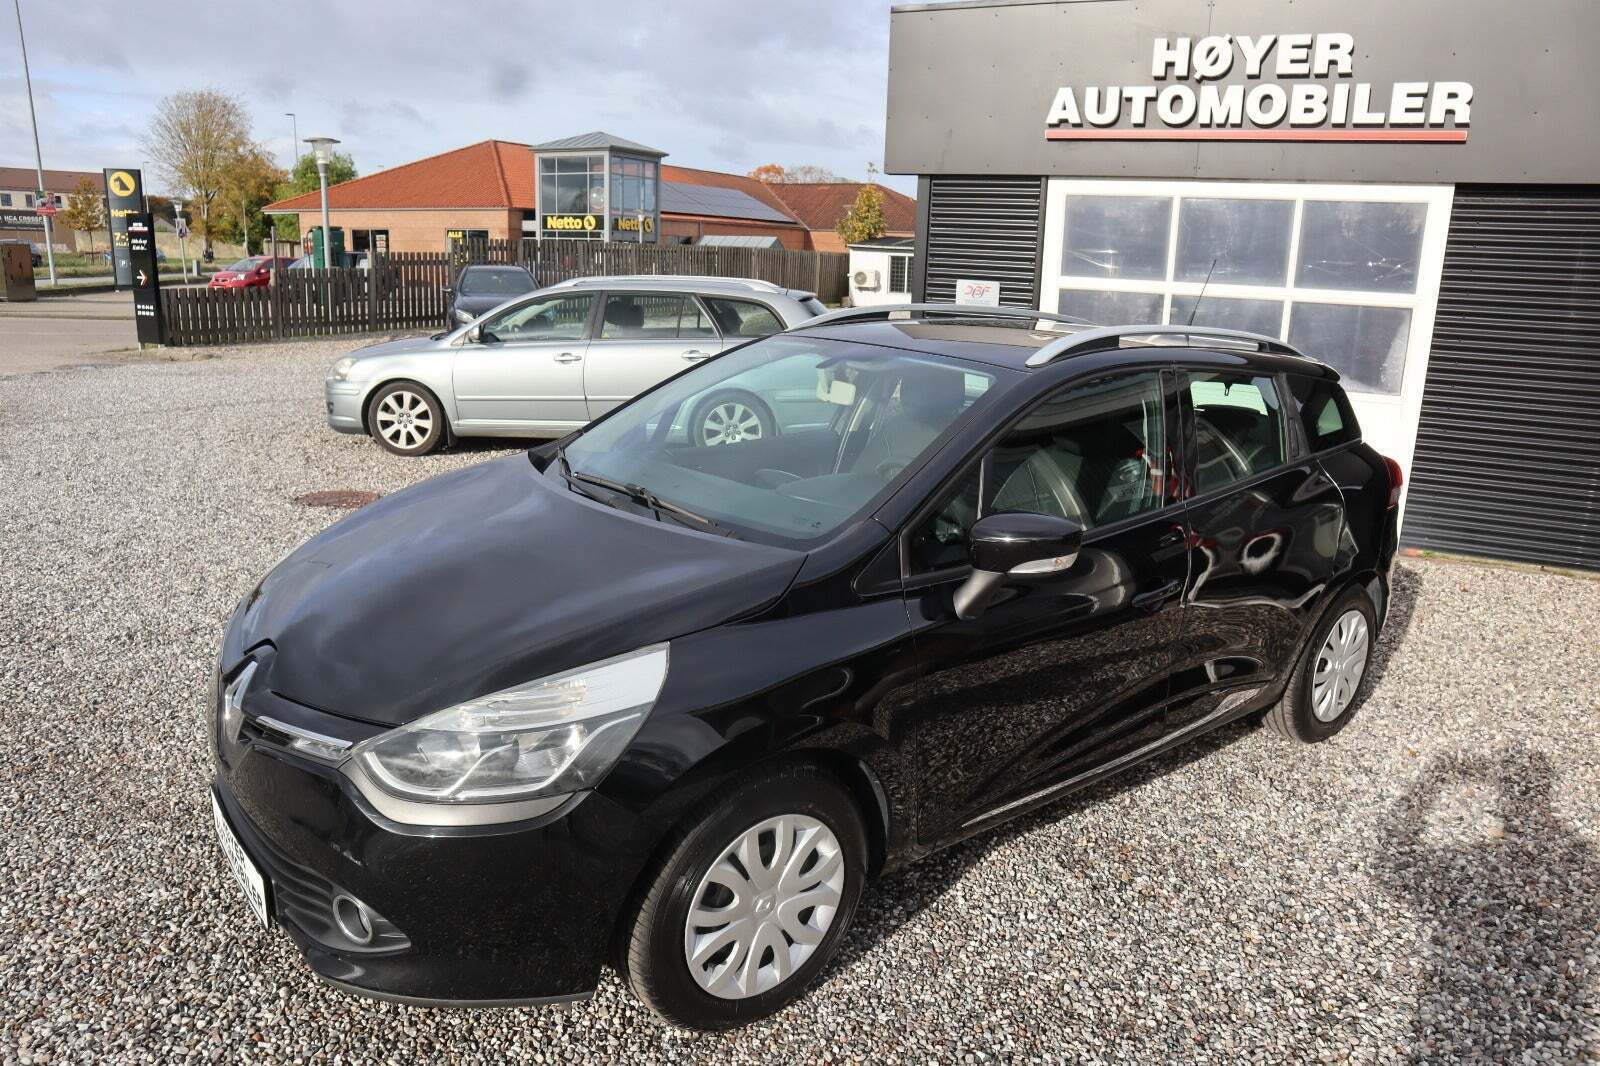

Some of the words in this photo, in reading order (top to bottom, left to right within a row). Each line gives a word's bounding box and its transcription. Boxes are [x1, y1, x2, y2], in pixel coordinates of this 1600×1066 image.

[1151, 32, 1355, 82] HØYER
[1045, 81, 1474, 128] AUTOMOBILER
[111, 208, 139, 217] Net
[546, 216, 582, 229] Netto
